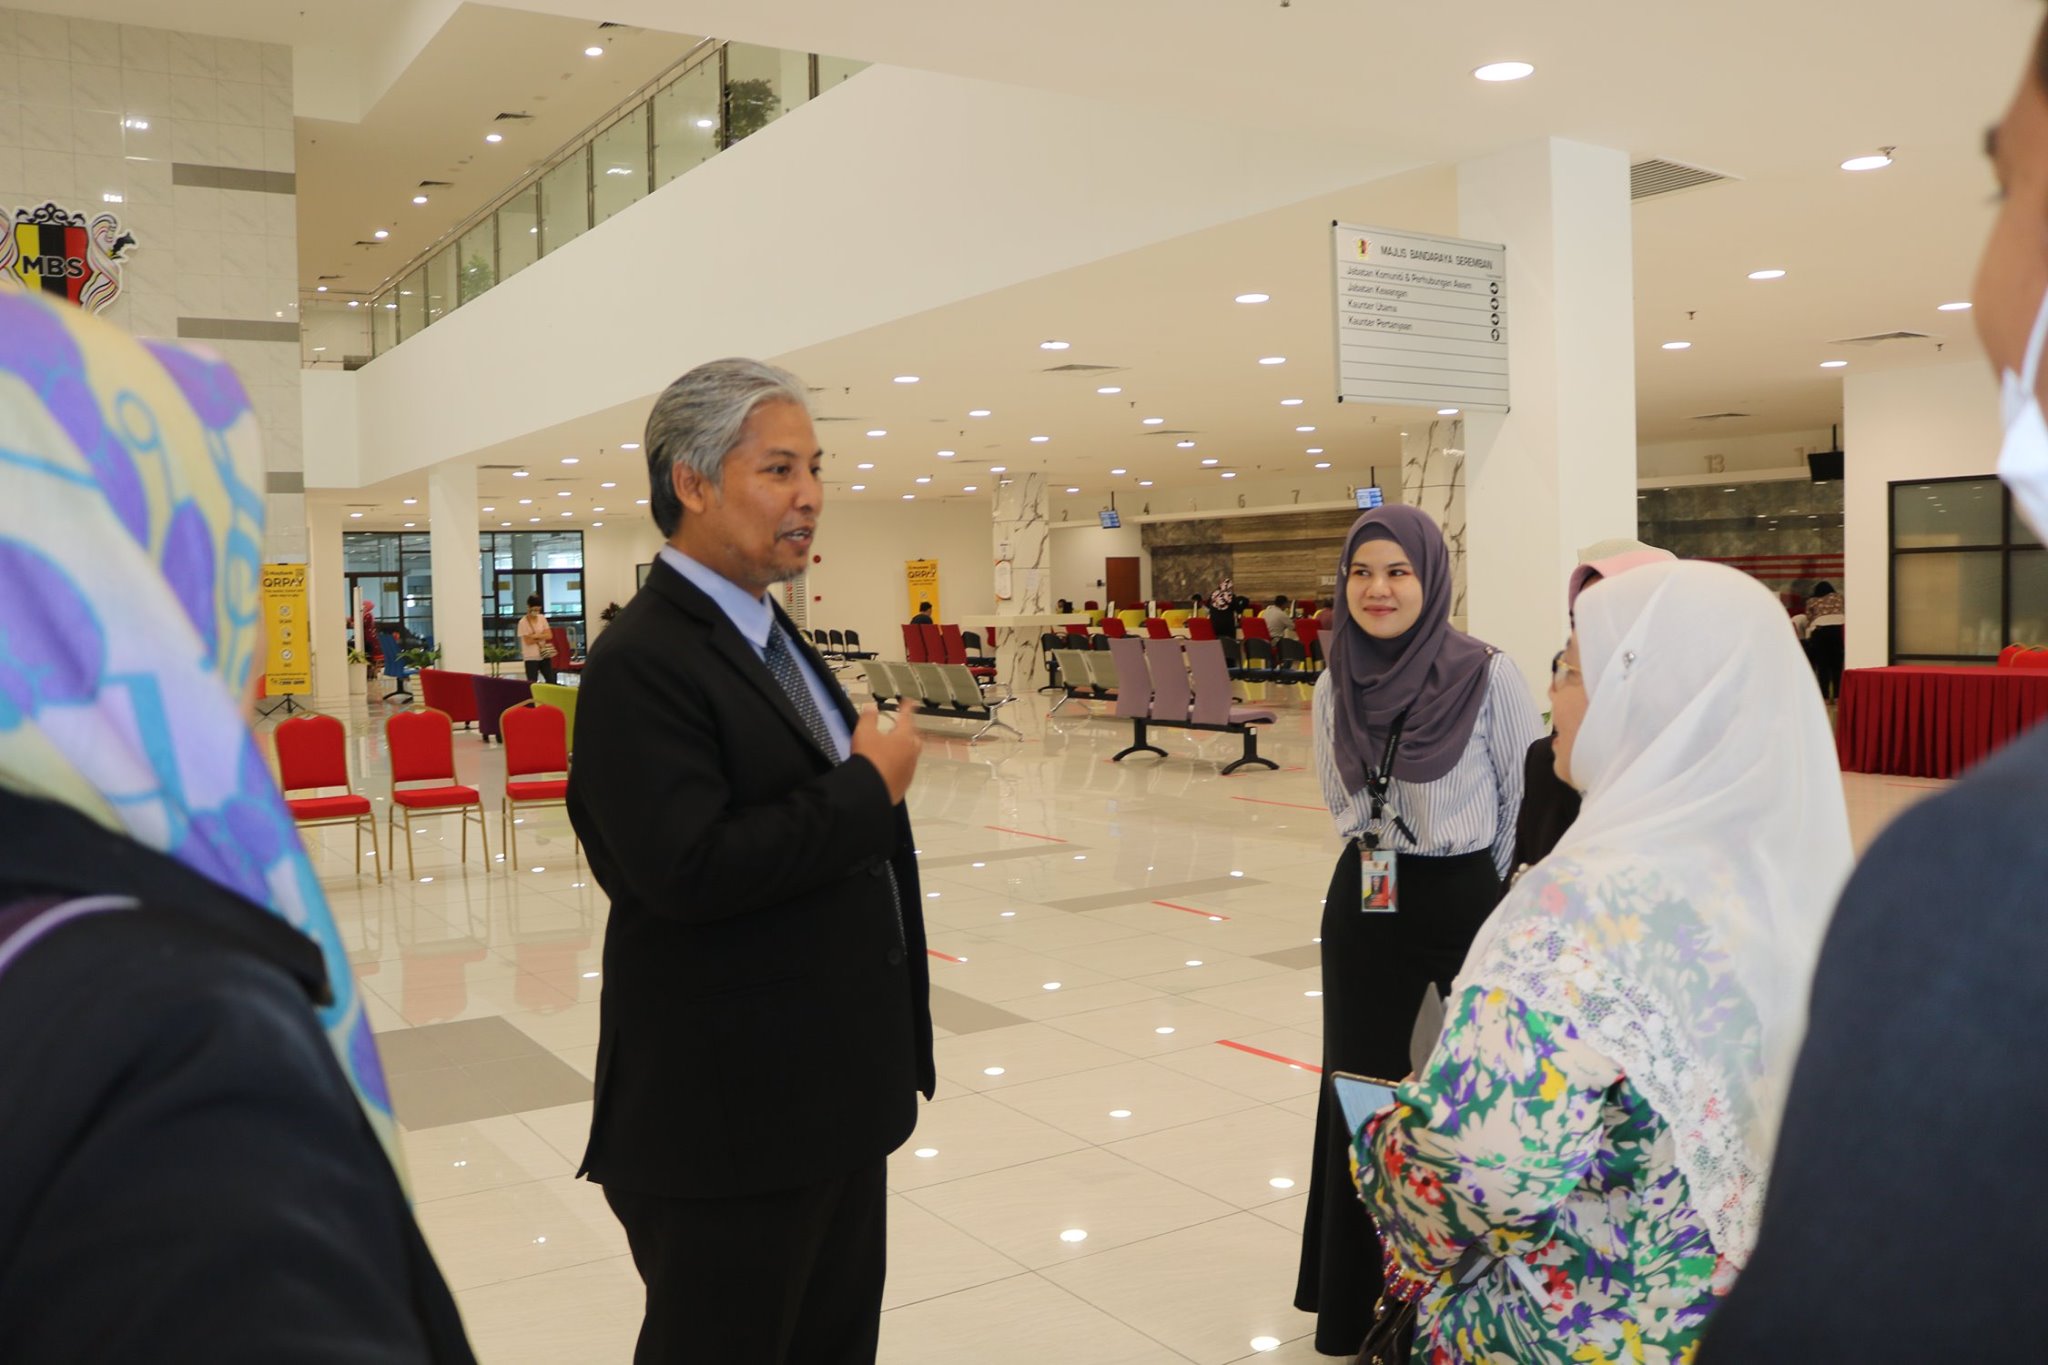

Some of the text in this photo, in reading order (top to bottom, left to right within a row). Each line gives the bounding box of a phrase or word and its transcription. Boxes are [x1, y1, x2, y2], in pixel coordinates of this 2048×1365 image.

[1380, 245, 1493, 270] MAJLIS BANDARAYA SEREMBAN
[22, 254, 85, 278] MBS
[1347, 266, 1373, 277] Jabatan
[1347, 283, 1373, 293] Jabatan
[1348, 299, 1375, 309] Kaunter
[1348, 315, 1375, 326] Kaunter
[1703, 453, 1726, 474] 13
[1237, 493, 1246, 508] 6
[1291, 489, 1300, 504] 7
[1061, 509, 1068, 521] 2
[1143, 502, 1150, 515] 4
